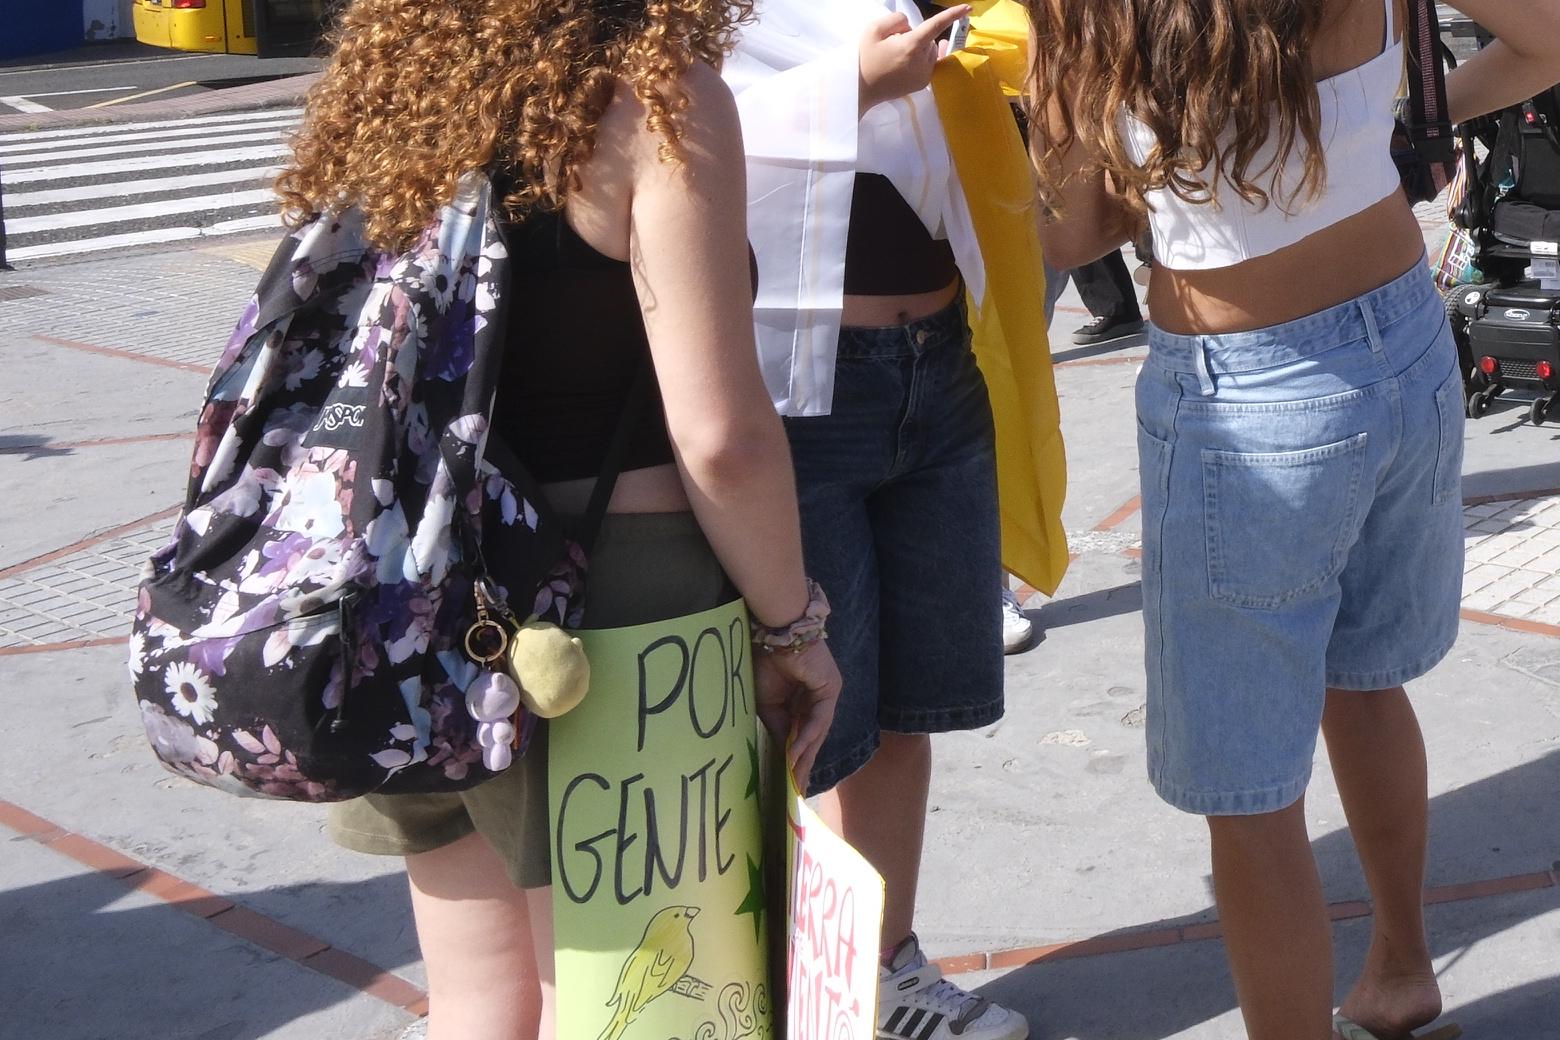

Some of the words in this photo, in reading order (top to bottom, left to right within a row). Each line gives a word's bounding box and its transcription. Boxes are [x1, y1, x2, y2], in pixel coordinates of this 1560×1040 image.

[637, 616, 748, 752] POR
[556, 754, 736, 905] GENTE
[788, 818, 857, 994] ERRA
